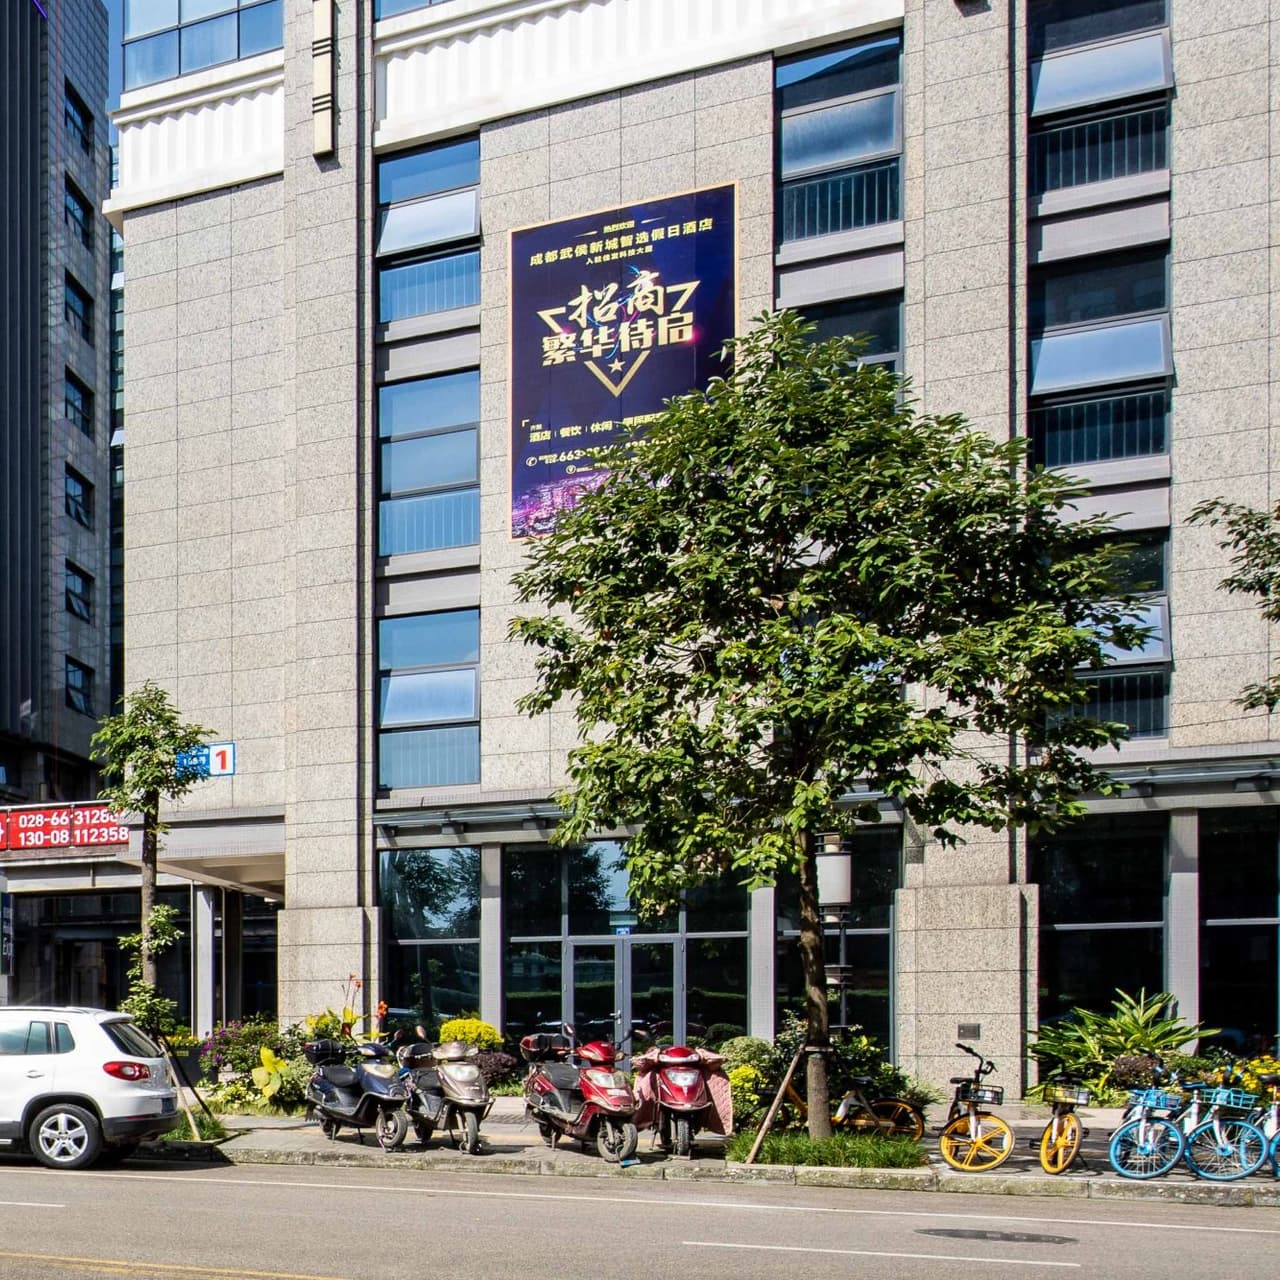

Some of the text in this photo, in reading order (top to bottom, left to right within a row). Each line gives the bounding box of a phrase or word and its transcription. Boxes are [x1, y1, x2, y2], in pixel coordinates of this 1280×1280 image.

[530, 217, 714, 267] 成都武侯新城智选假日酒店
[568, 270, 665, 328] 招商
[541, 311, 694, 367] 繁华待启
[215, 749, 228, 770] 1
[18, 827, 129, 846] 130-08112358
